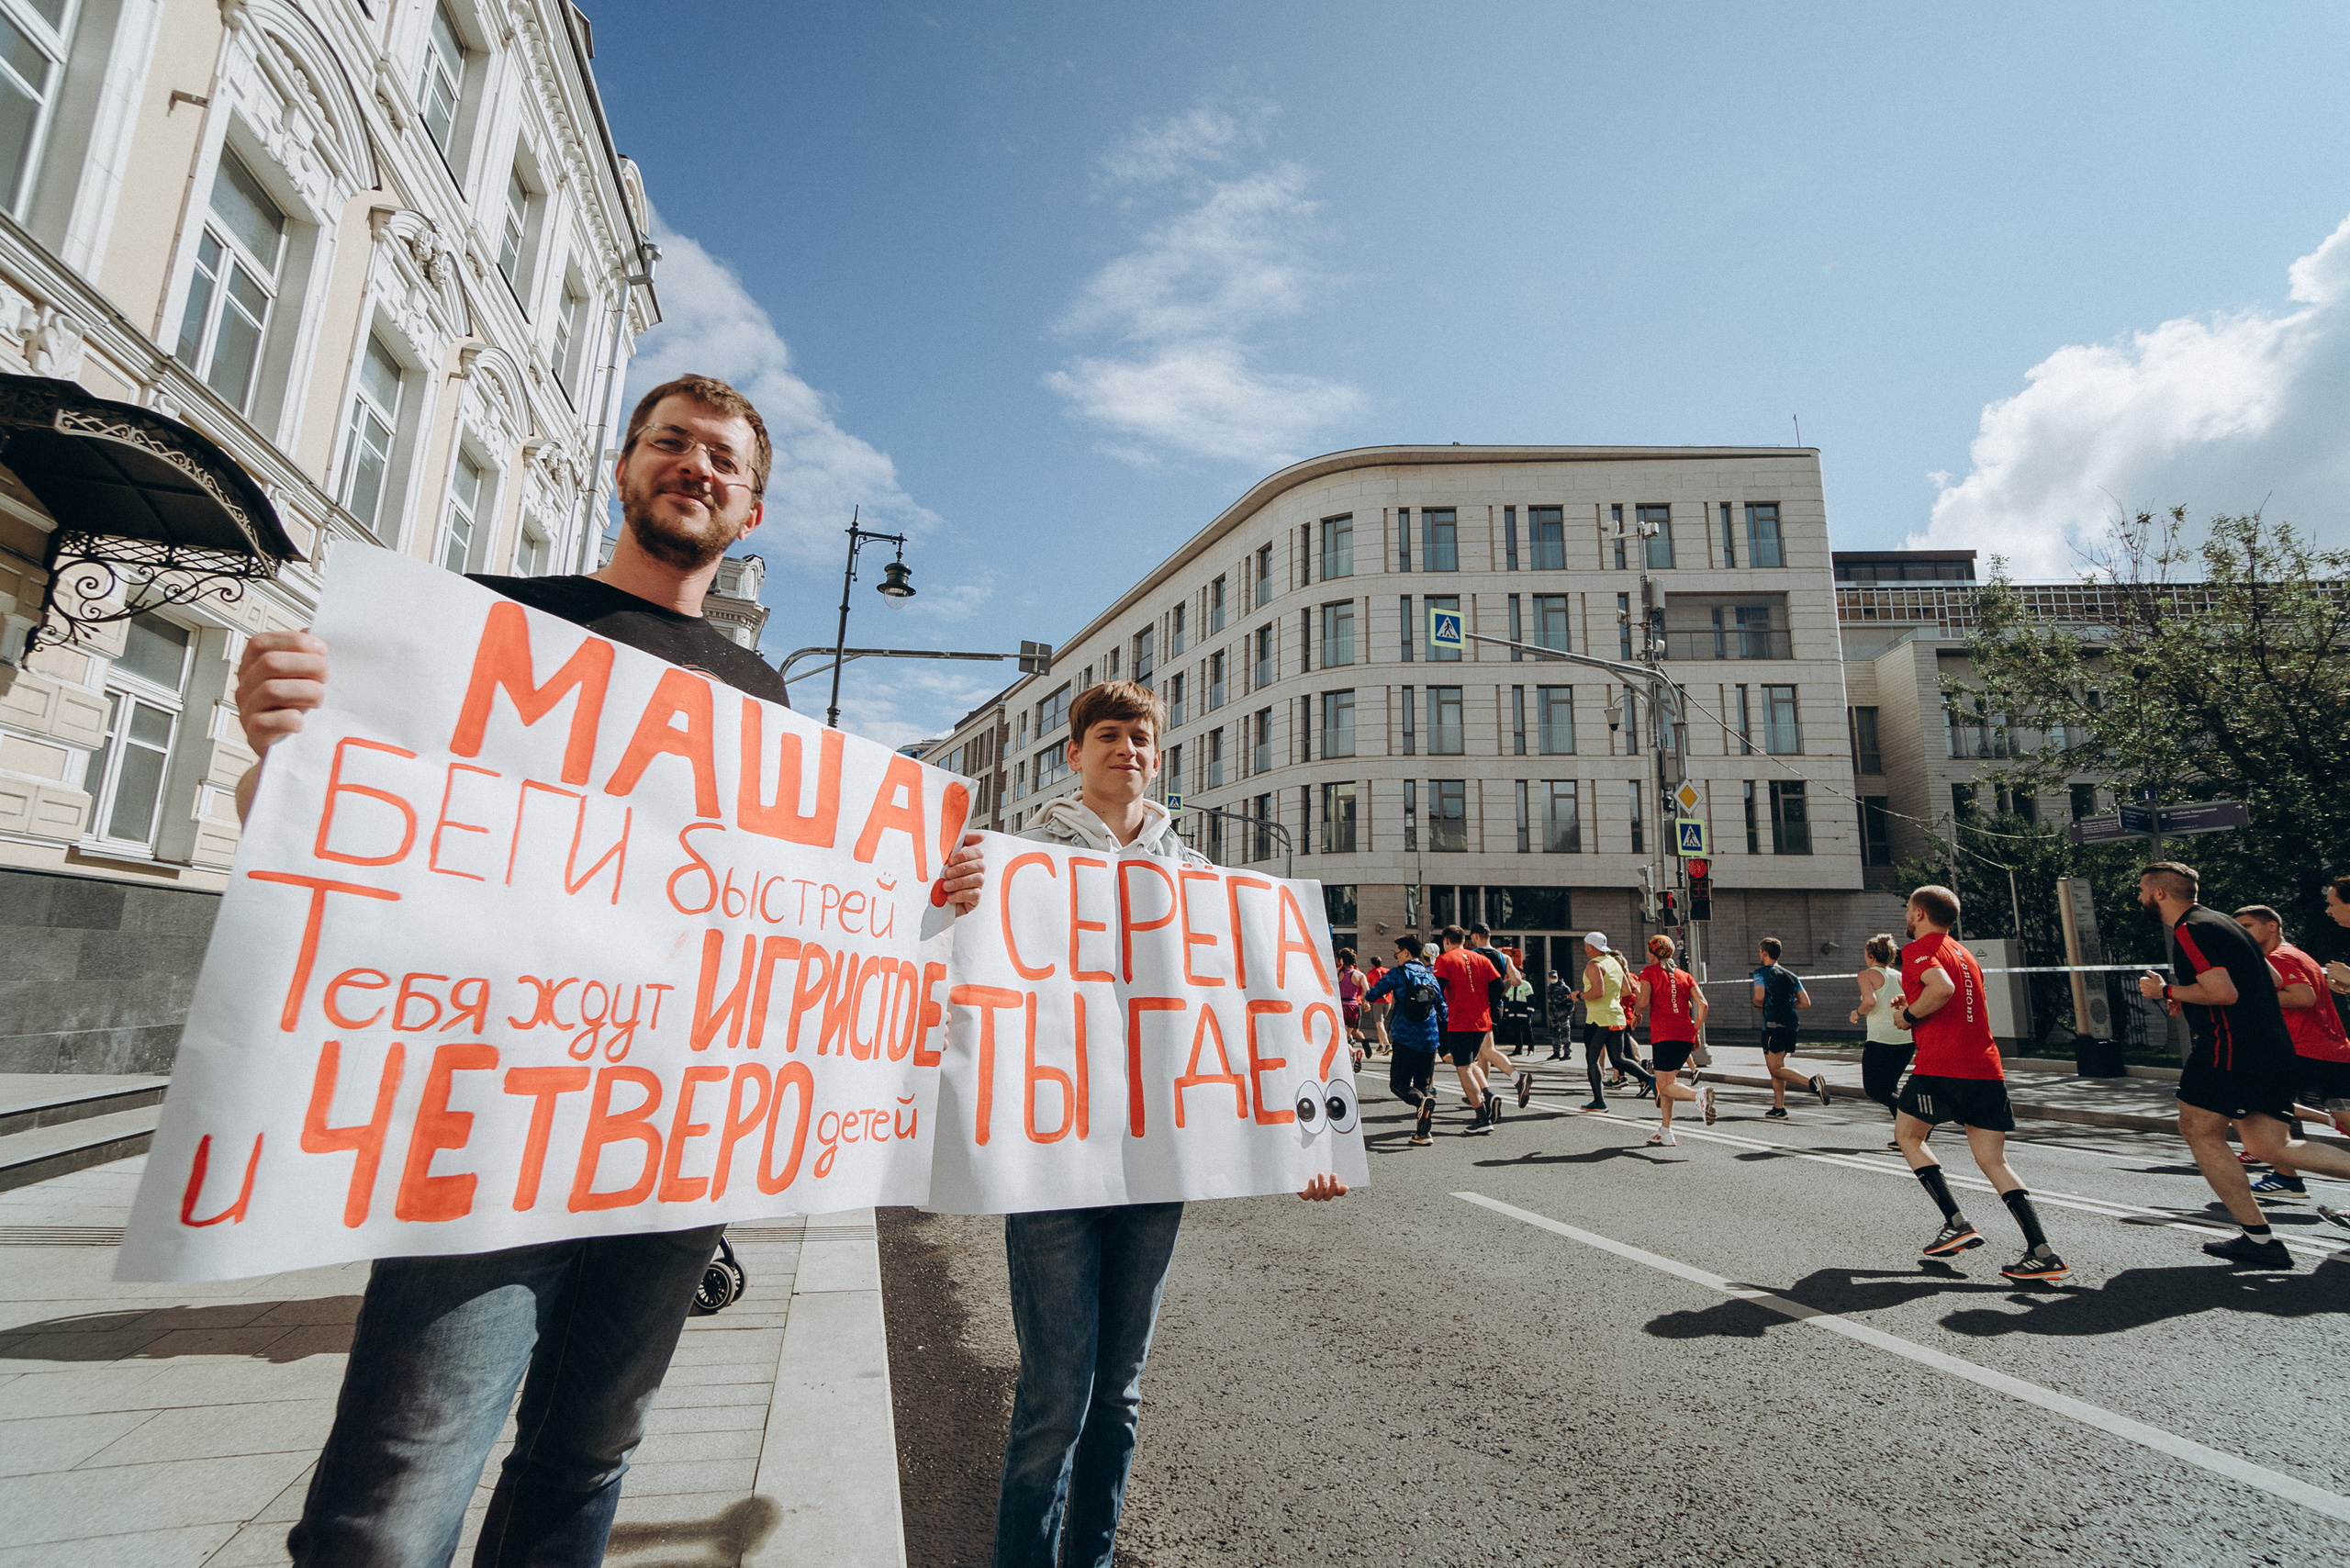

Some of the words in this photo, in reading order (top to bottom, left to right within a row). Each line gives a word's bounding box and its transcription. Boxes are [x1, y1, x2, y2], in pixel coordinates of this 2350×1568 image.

[450, 601, 969, 907] МАША!
[314, 737, 632, 905] БЕГИ
[667, 822, 895, 939] быстрей
[1692, 880, 1709, 898] 35
[508, 973, 675, 1063] ждут
[690, 929, 946, 1067] ИГРИСТОЕ
[1001, 852, 1334, 997] СЕРЁГА
[301, 1041, 814, 1228] ЧЕТВЕРО
[813, 1093, 918, 1179] детей
[949, 984, 1090, 1147] ТЫ
[1128, 997, 1340, 1138] ГДЕ?
